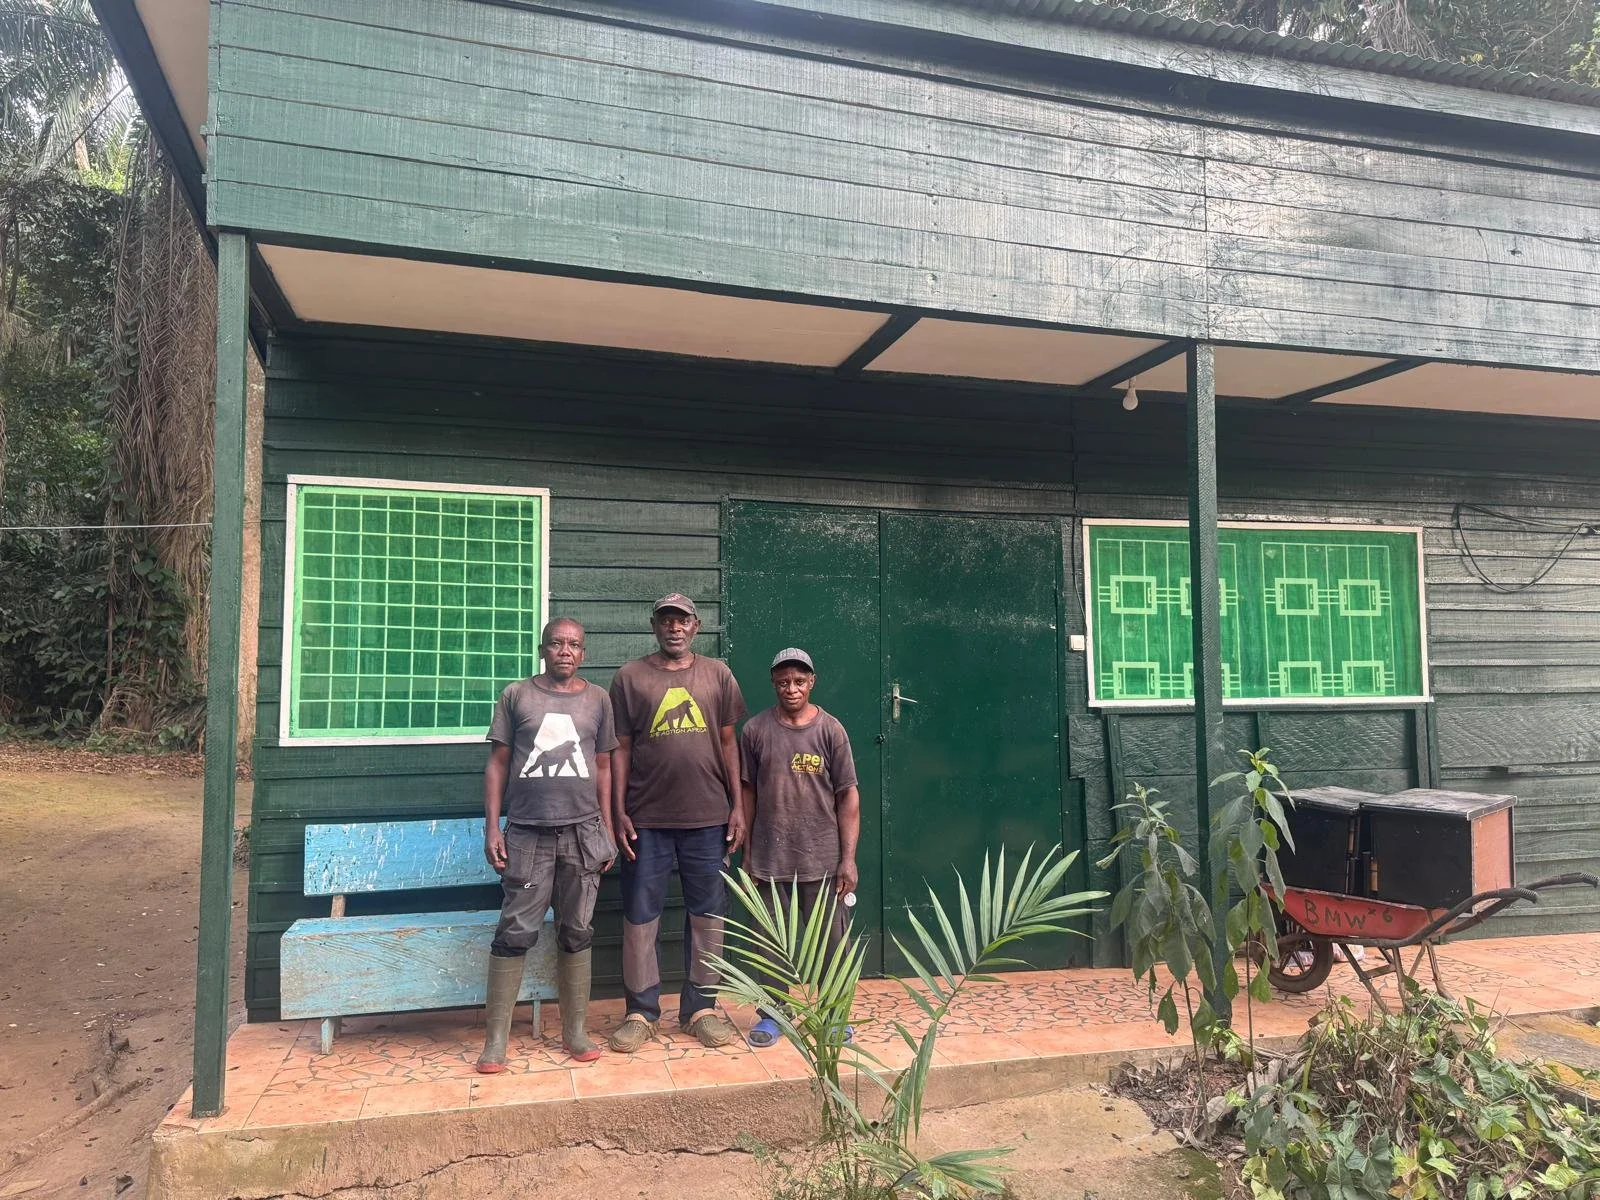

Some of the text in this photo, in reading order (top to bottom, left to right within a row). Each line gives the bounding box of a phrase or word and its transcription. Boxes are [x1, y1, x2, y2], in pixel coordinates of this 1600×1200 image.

[660, 728, 686, 736] ACTION
[791, 762, 819, 772] ACTION
[1304, 898, 1366, 929] BMW
